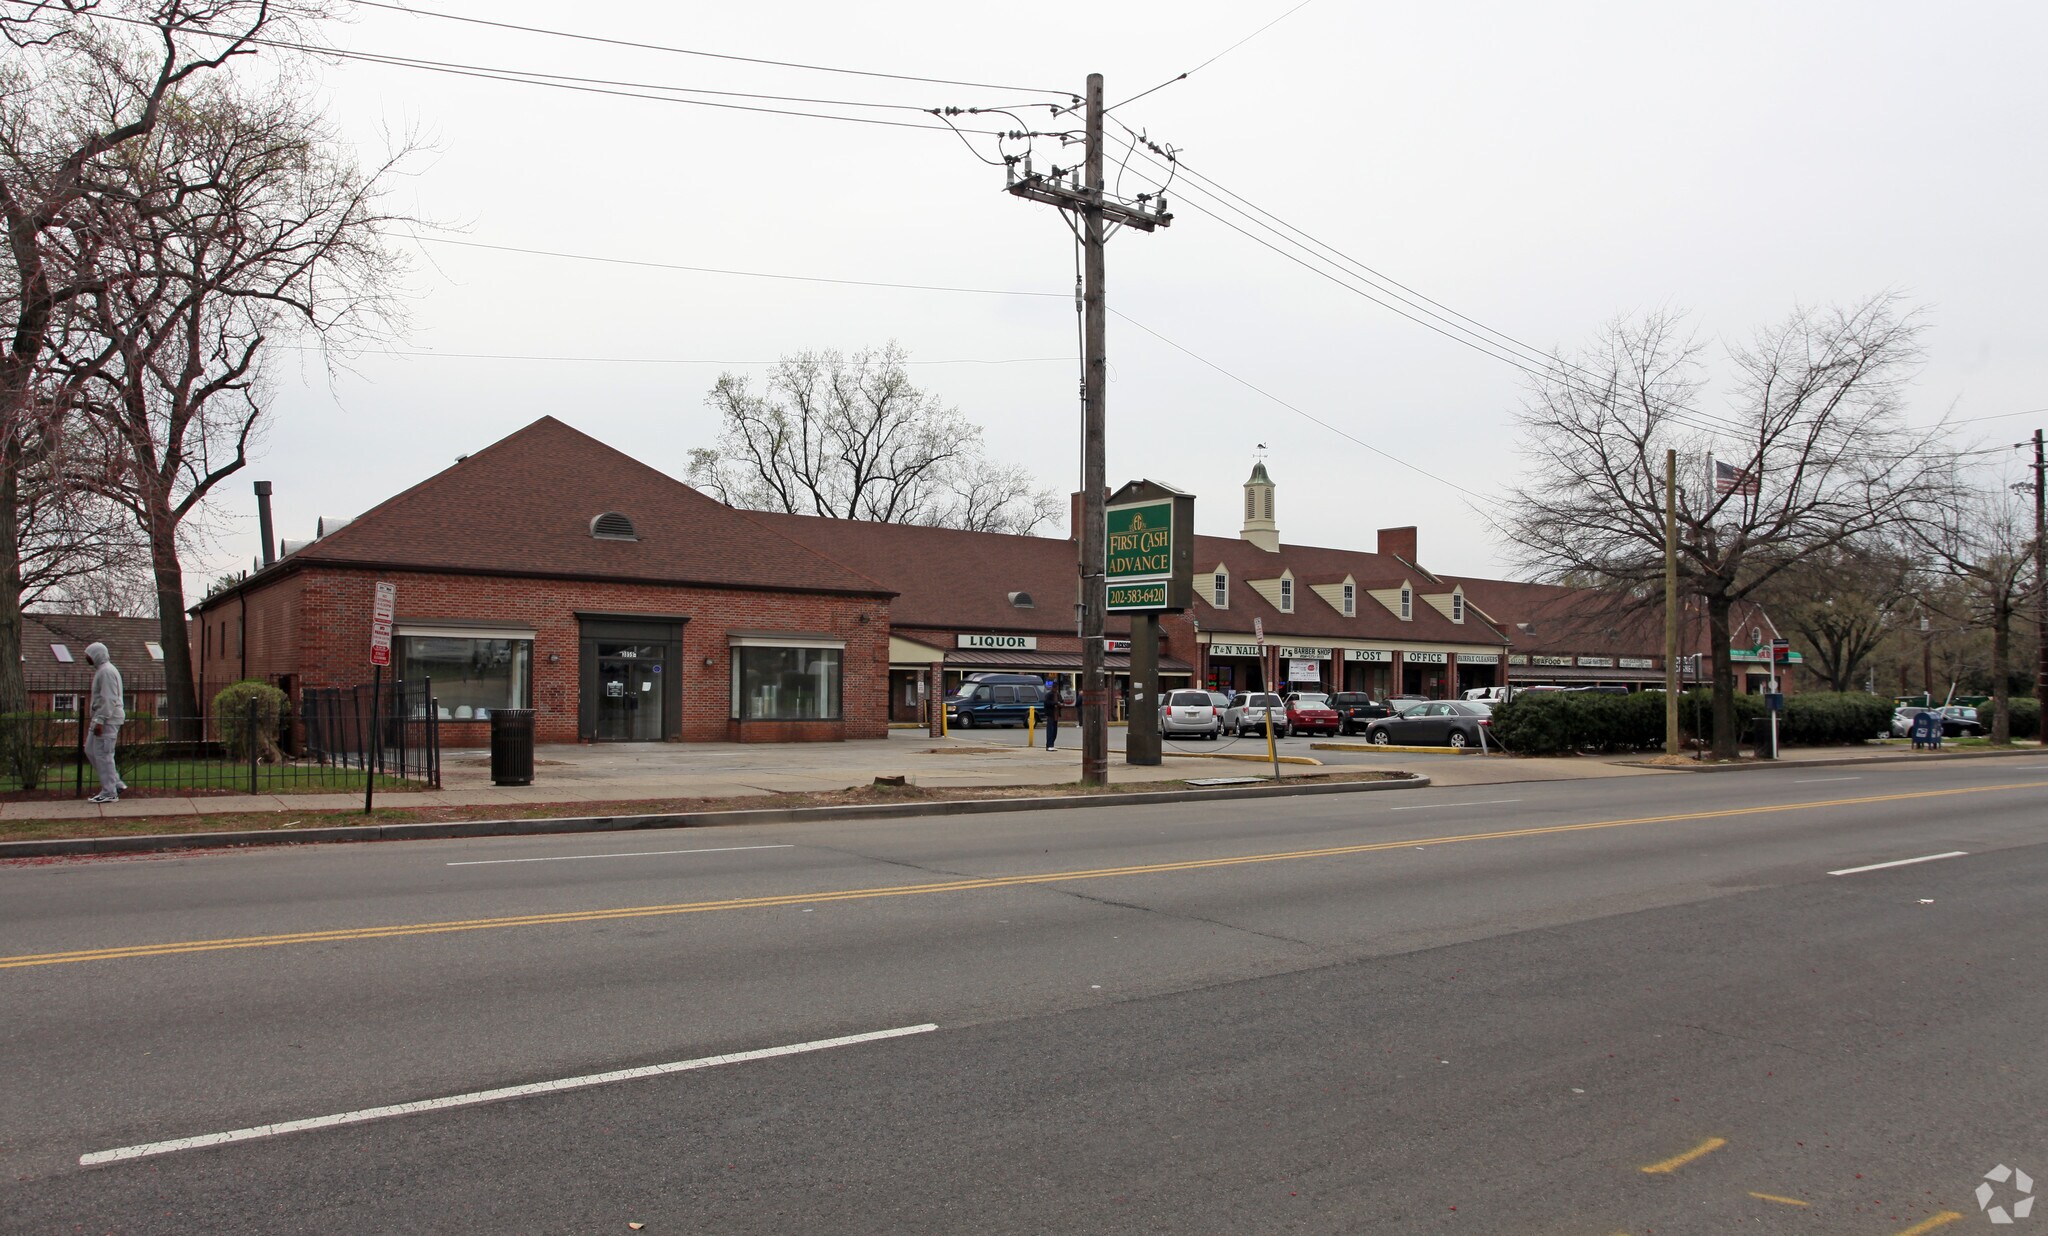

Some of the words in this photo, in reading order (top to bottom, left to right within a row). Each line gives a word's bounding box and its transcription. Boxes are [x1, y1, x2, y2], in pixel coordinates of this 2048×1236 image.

[1110, 535, 1138, 555] FIRST
[1140, 531, 1168, 553] CASH
[1109, 555, 1168, 573] ADVANCE
[1110, 588, 1164, 604] 202-583-6420
[970, 636, 1026, 647] LIQUOR
[1294, 648, 1316, 656] BARBER
[1355, 651, 1382, 661] POST
[1410, 652, 1442, 663] OFFICE
